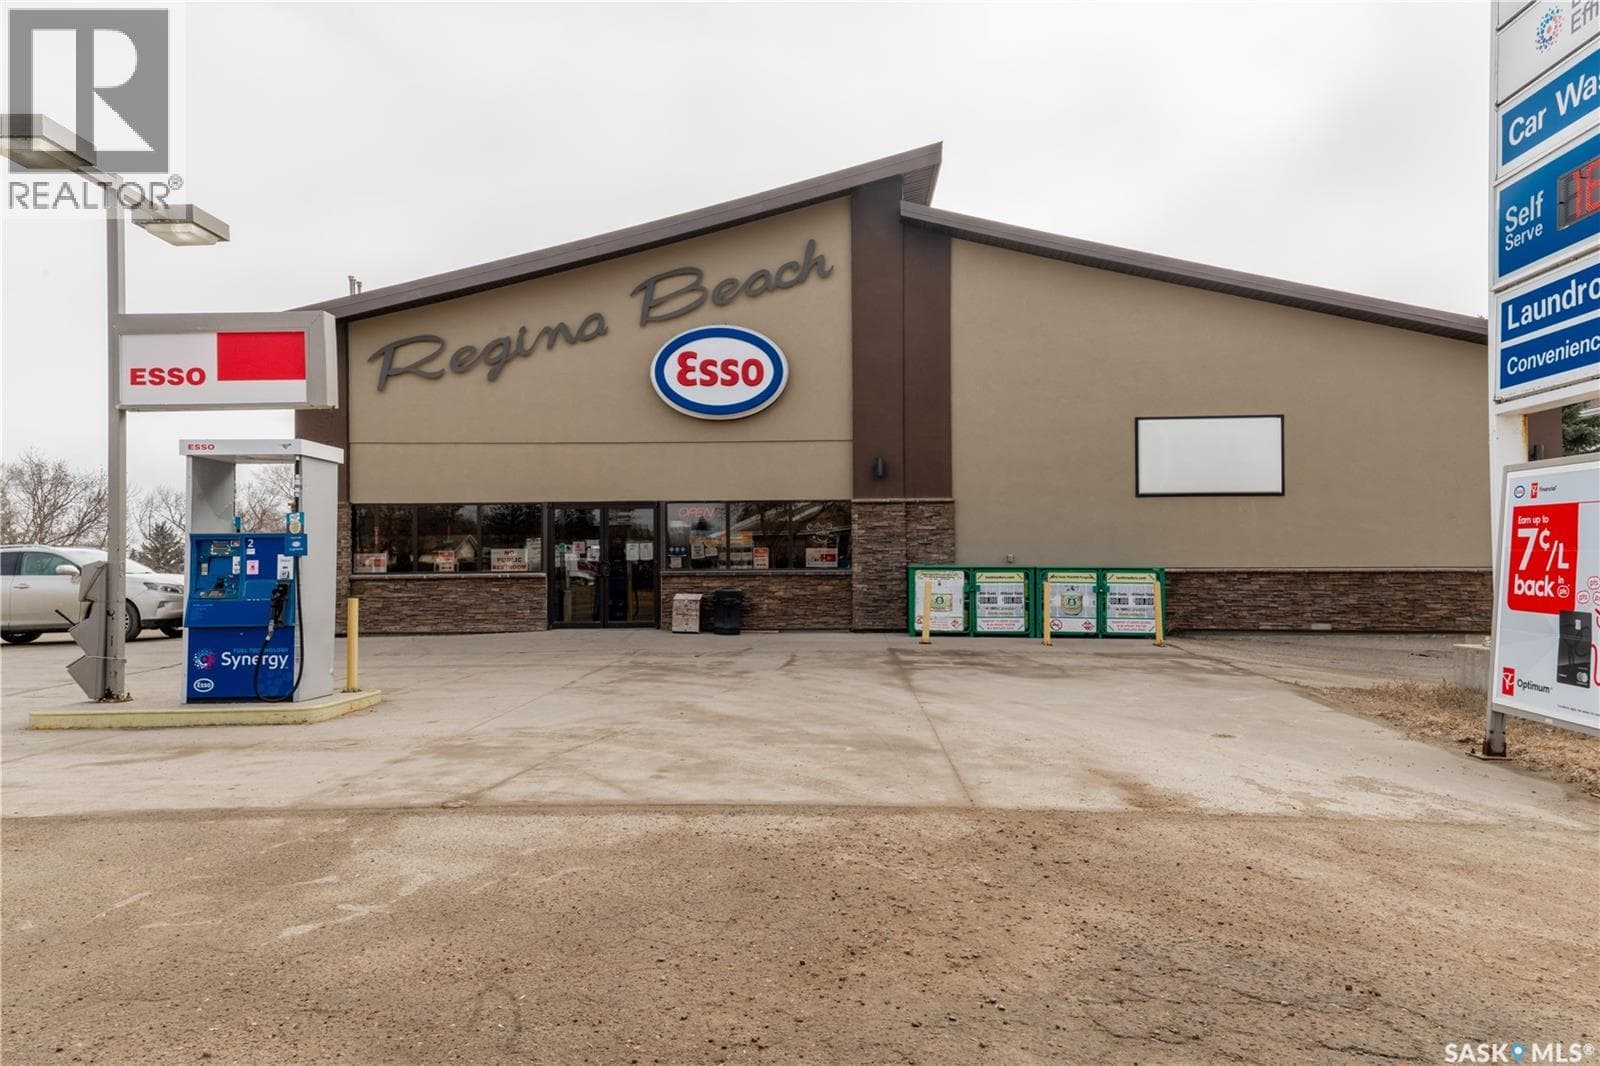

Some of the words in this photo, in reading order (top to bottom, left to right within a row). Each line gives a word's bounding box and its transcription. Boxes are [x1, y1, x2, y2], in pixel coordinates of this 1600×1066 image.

[1508, 107, 1547, 146] Car
[1555, 74, 1600, 116] Wa
[1505, 190, 1544, 233] Self
[1505, 223, 1543, 251] Serve
[367, 312, 609, 393] Regina
[630, 238, 834, 327] Beach
[130, 367, 206, 386] ESSO
[676, 351, 765, 387] Esso
[187, 443, 215, 451] ESSO
[679, 507, 716, 518] OPEN
[1518, 515, 1531, 525] Earn
[1532, 516, 1541, 526] up
[1542, 515, 1549, 524] to
[247, 539, 255, 548] 2
[1514, 573, 1555, 597] back
[221, 651, 289, 670] Synergy
[1517, 678, 1550, 694] Optimum
